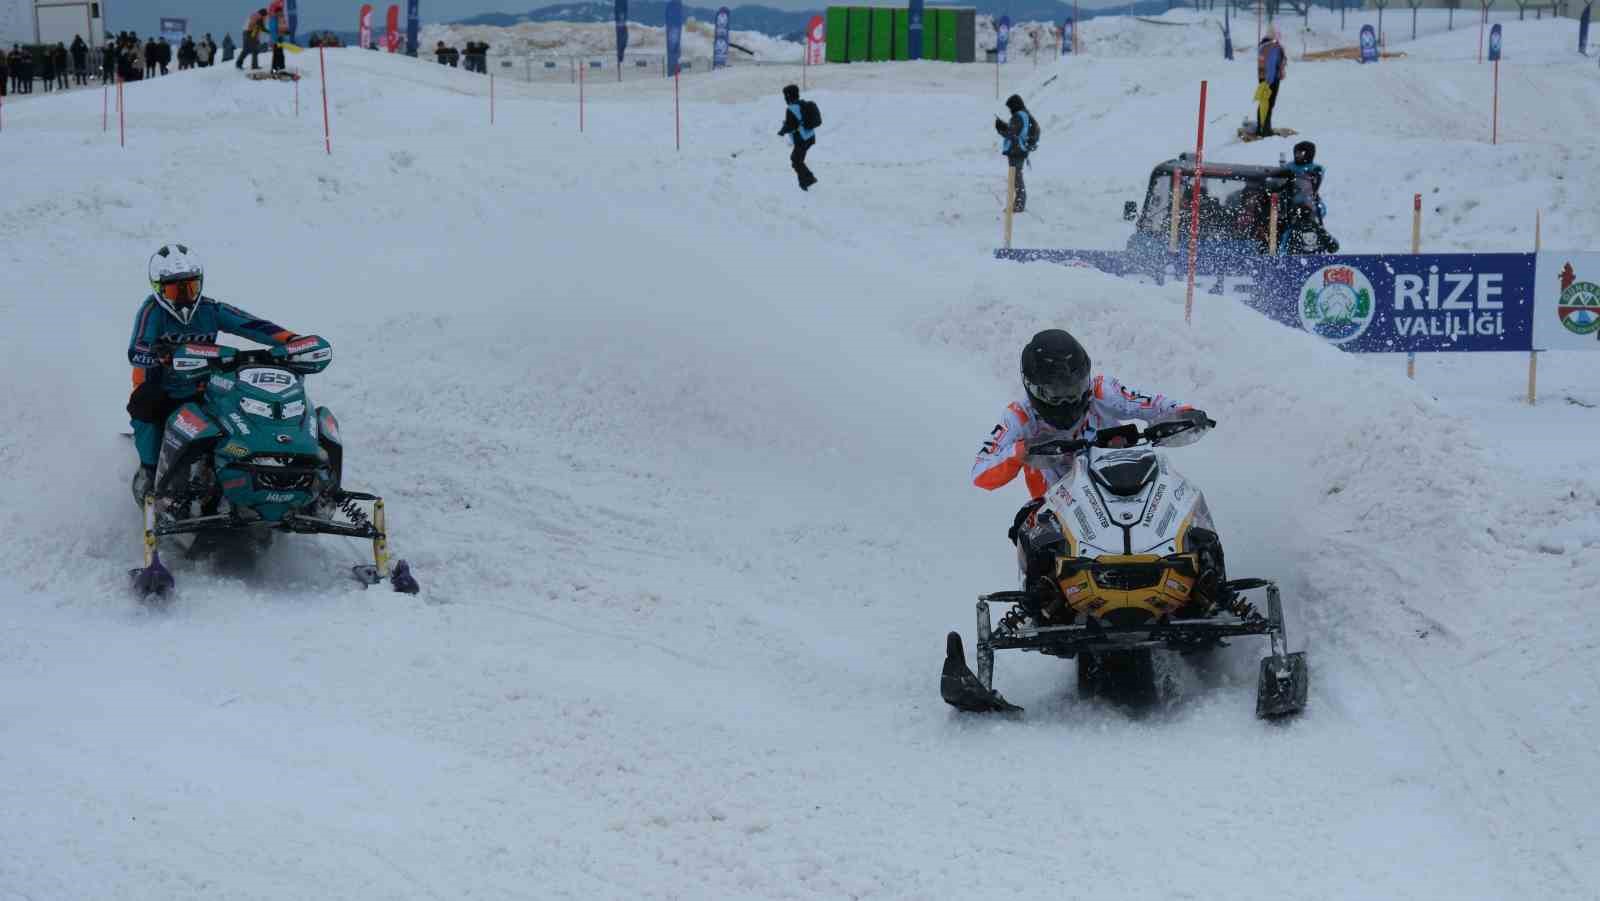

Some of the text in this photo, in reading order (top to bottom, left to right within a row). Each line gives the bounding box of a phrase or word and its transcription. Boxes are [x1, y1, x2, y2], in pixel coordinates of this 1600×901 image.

[1394, 265, 1503, 310] RİZE
[1394, 312, 1503, 336] VALİLİĞİ
[250, 373, 291, 384] 169
